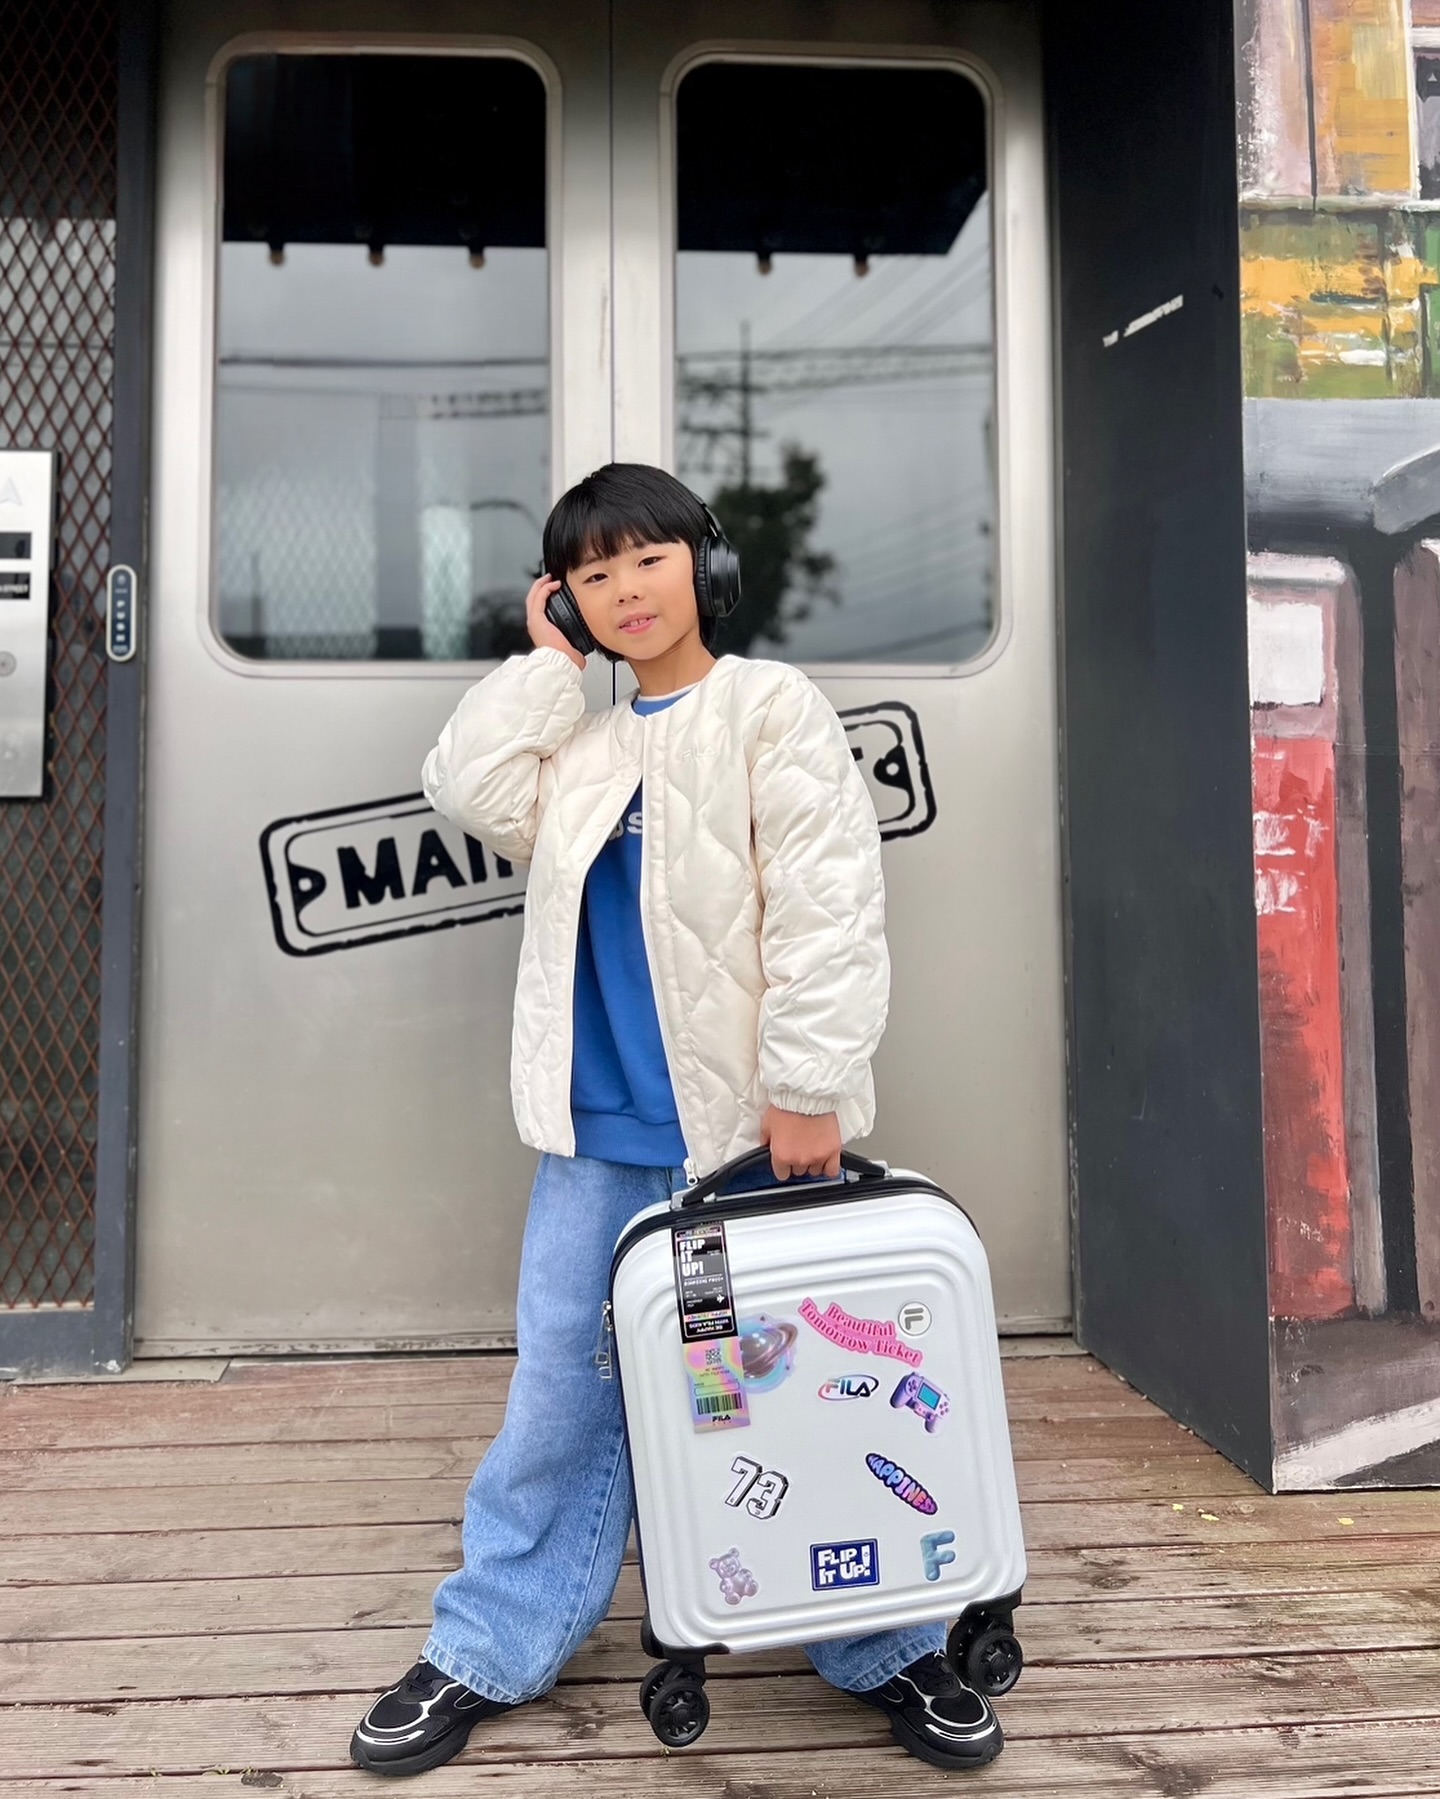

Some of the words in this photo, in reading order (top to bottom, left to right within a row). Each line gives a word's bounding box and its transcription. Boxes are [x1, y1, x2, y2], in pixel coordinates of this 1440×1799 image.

[337, 828, 514, 910] MAI
[680, 1239, 705, 1251] FLIP
[681, 1250, 693, 1263] IT
[682, 1261, 704, 1277] UP!
[827, 1305, 894, 1337] Beautiful
[801, 1302, 868, 1351] Tomorrow
[876, 1339, 920, 1364] Ticket
[825, 1379, 871, 1398] FILA
[712, 1414, 731, 1422] FILA
[725, 1456, 788, 1520] 73
[818, 1548, 857, 1568] FLIP
[920, 1530, 956, 1582] F
[818, 1568, 836, 1586] IT
